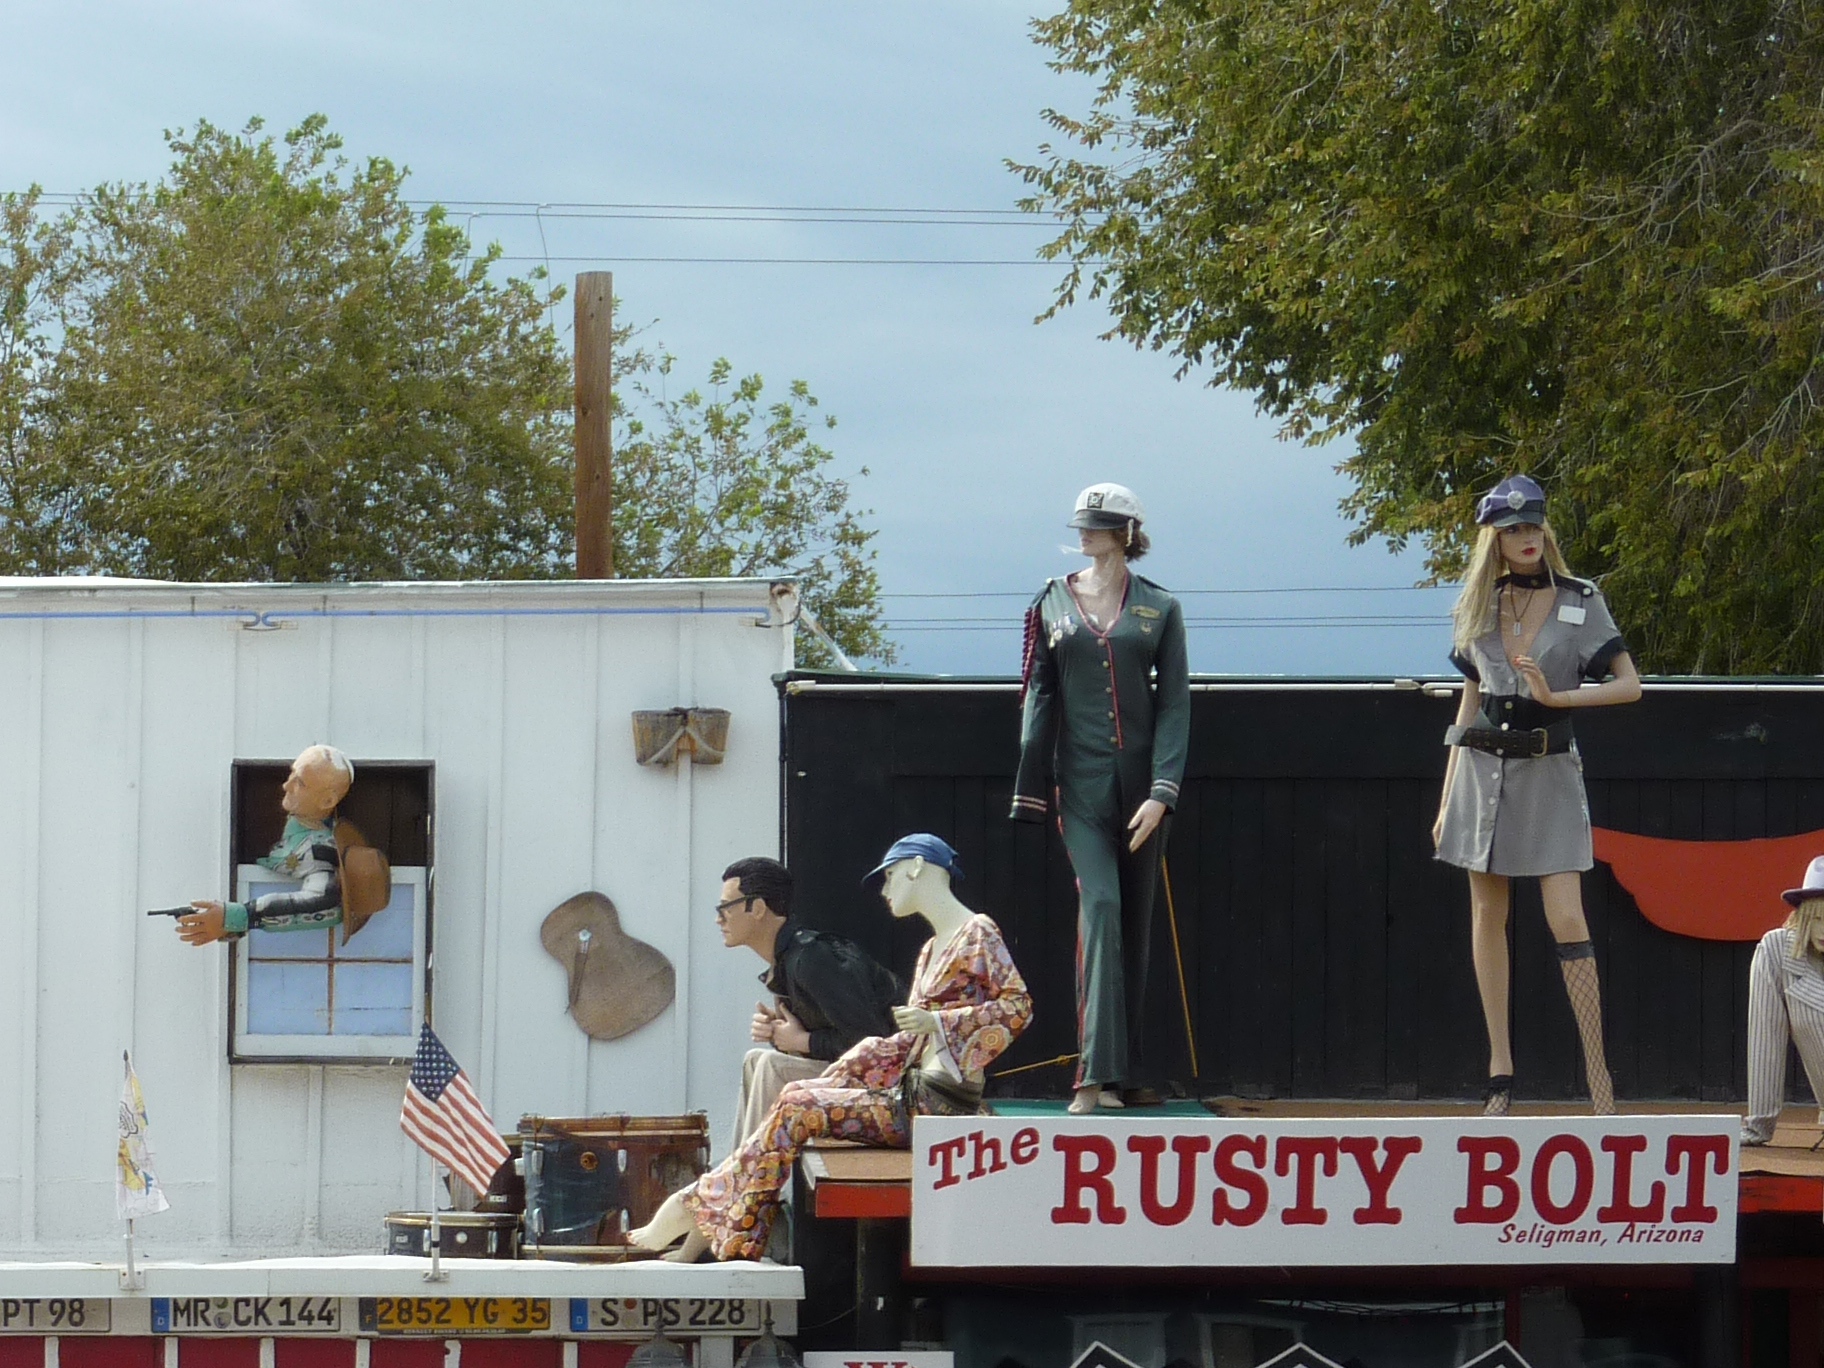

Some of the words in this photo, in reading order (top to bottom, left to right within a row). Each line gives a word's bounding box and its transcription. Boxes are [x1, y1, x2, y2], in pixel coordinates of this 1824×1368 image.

[927, 1125, 1040, 1192] The
[1051, 1133, 1423, 1227] RUSTY
[1454, 1133, 1729, 1226] BOLT
[1498, 1222, 1608, 1247] Seligman,
[1619, 1221, 1705, 1244] Arizona
[2, 1299, 40, 1328] PT
[48, 1299, 87, 1327] 98
[173, 1299, 212, 1327] MR
[232, 1299, 273, 1327] CK
[280, 1299, 336, 1326] 144
[378, 1298, 451, 1324] 2852
[465, 1298, 499, 1324] YG
[512, 1298, 548, 1324] 35
[601, 1299, 620, 1327] S
[642, 1299, 678, 1327] PS
[687, 1299, 746, 1326] 228
